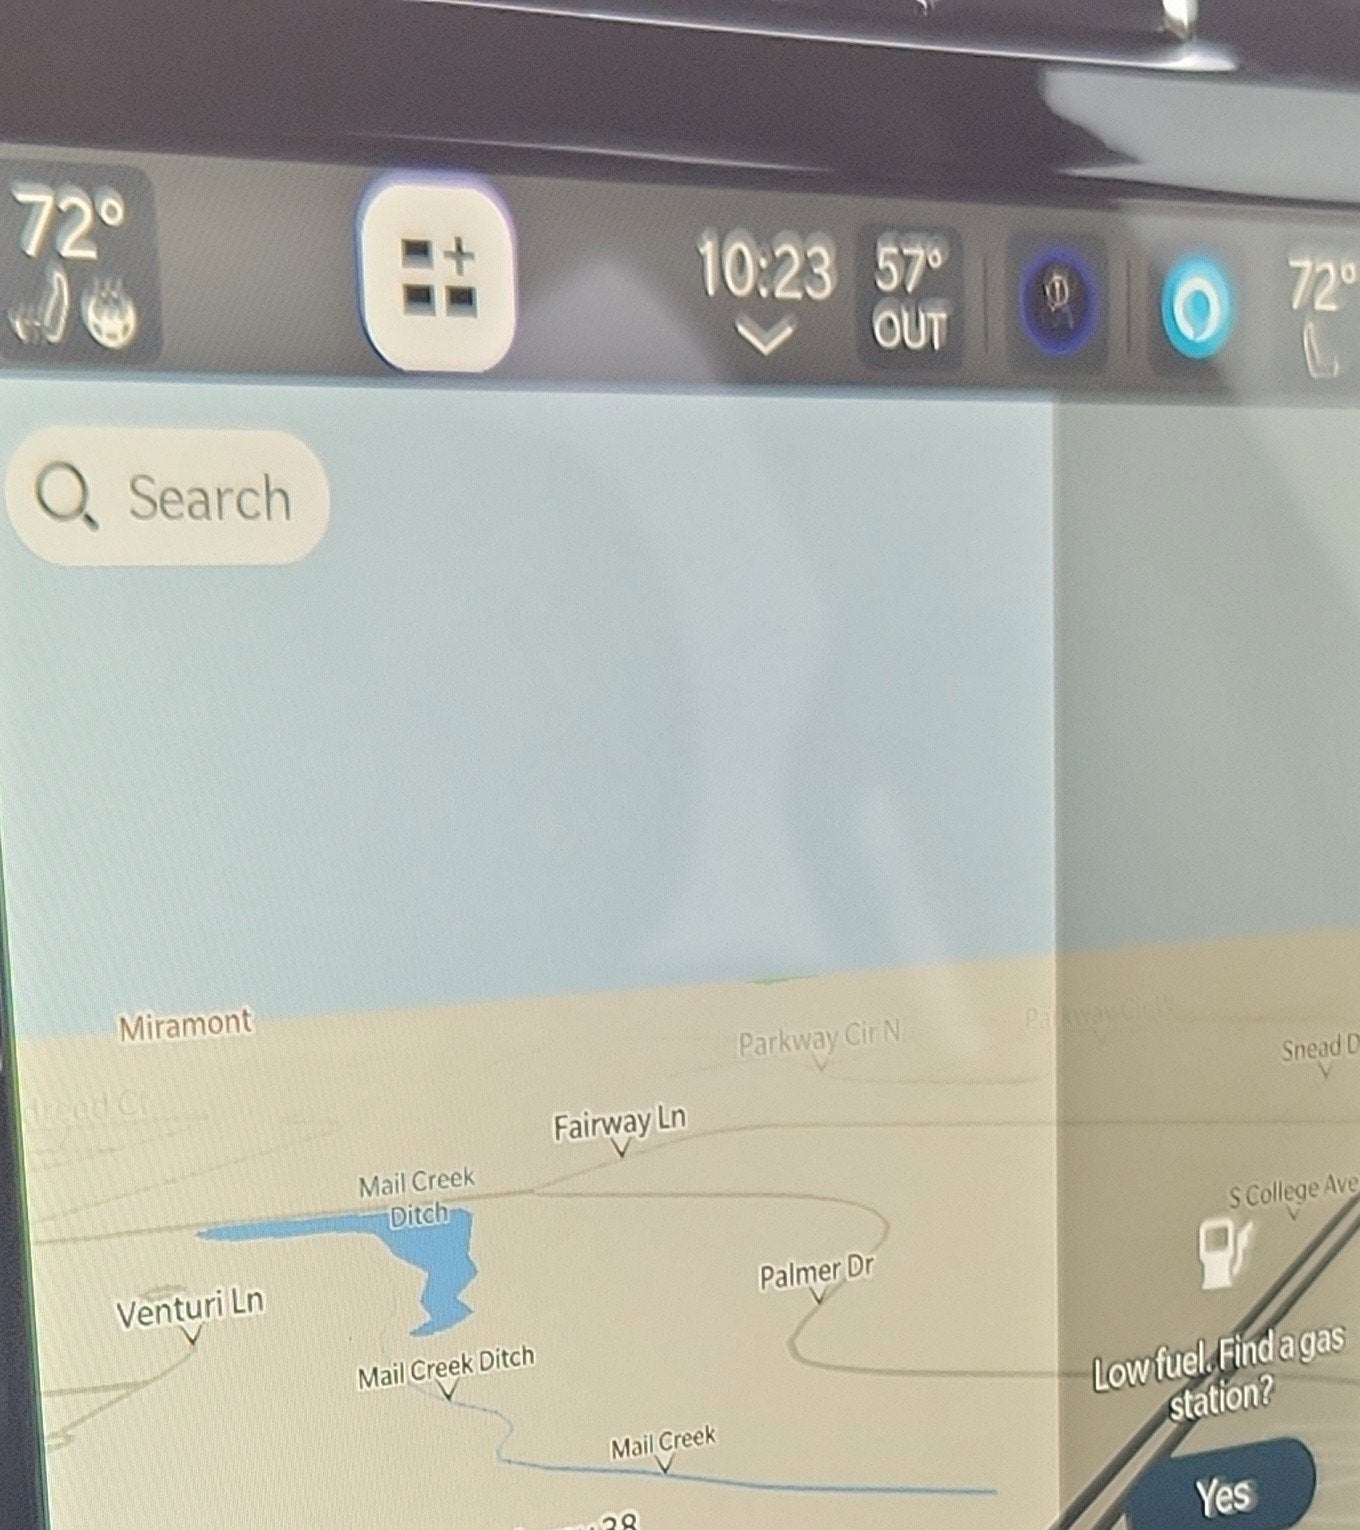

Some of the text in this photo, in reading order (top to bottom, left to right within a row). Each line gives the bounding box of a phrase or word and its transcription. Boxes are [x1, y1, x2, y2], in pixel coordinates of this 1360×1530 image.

[697, 232, 836, 301] 10:23
[872, 308, 947, 351] OUT
[128, 473, 292, 523] Search
[118, 1007, 254, 1043] Miramont
[738, 1017, 901, 1060] Parkway Cir N
[1281, 1037, 1342, 1063] Snead
[553, 1105, 686, 1143] Fairway Ln
[358, 1165, 476, 1198] Mail Creek
[1228, 1174, 1359, 1209] S College Ave
[389, 1201, 449, 1230] Ditch
[760, 1253, 875, 1291] Palmer Dr
[116, 1288, 265, 1330] Venturi Ln
[357, 1345, 536, 1390] Mail Creek Ditch
[1093, 1325, 1345, 1391] Low fuel. Find a gas
[1169, 1375, 1274, 1422] station?
[610, 1425, 717, 1460] Mail Creek
[1196, 1477, 1252, 1519] Yes
